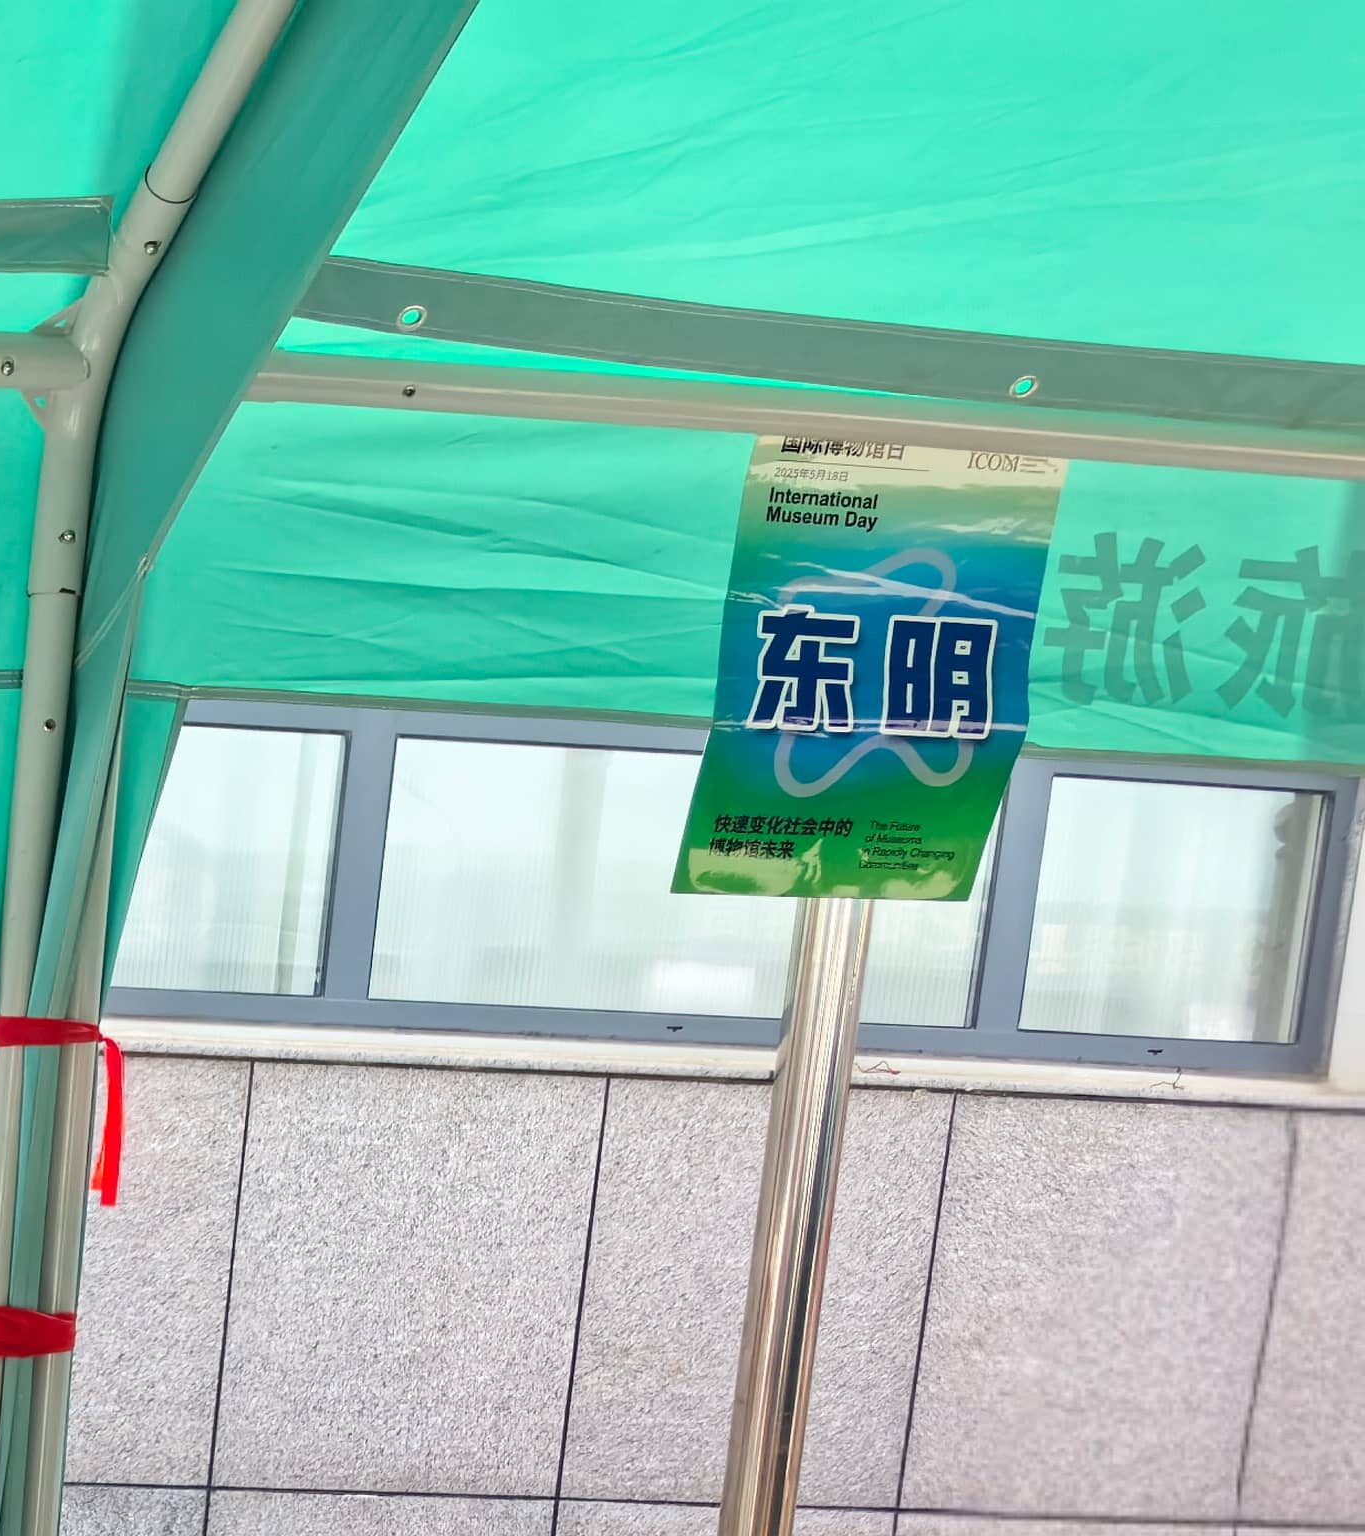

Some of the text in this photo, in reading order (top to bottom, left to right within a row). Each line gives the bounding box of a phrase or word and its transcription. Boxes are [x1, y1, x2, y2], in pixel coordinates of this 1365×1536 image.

[780, 435, 905, 461] 国际博物馆日
[774, 467, 849, 483] 2025年5月18日
[769, 487, 879, 510] International
[766, 506, 878, 532] Museum Day
[746, 605, 999, 739] 东明
[714, 815, 853, 838] 快速变化社会中的
[709, 838, 795, 861] 博物馆未来
